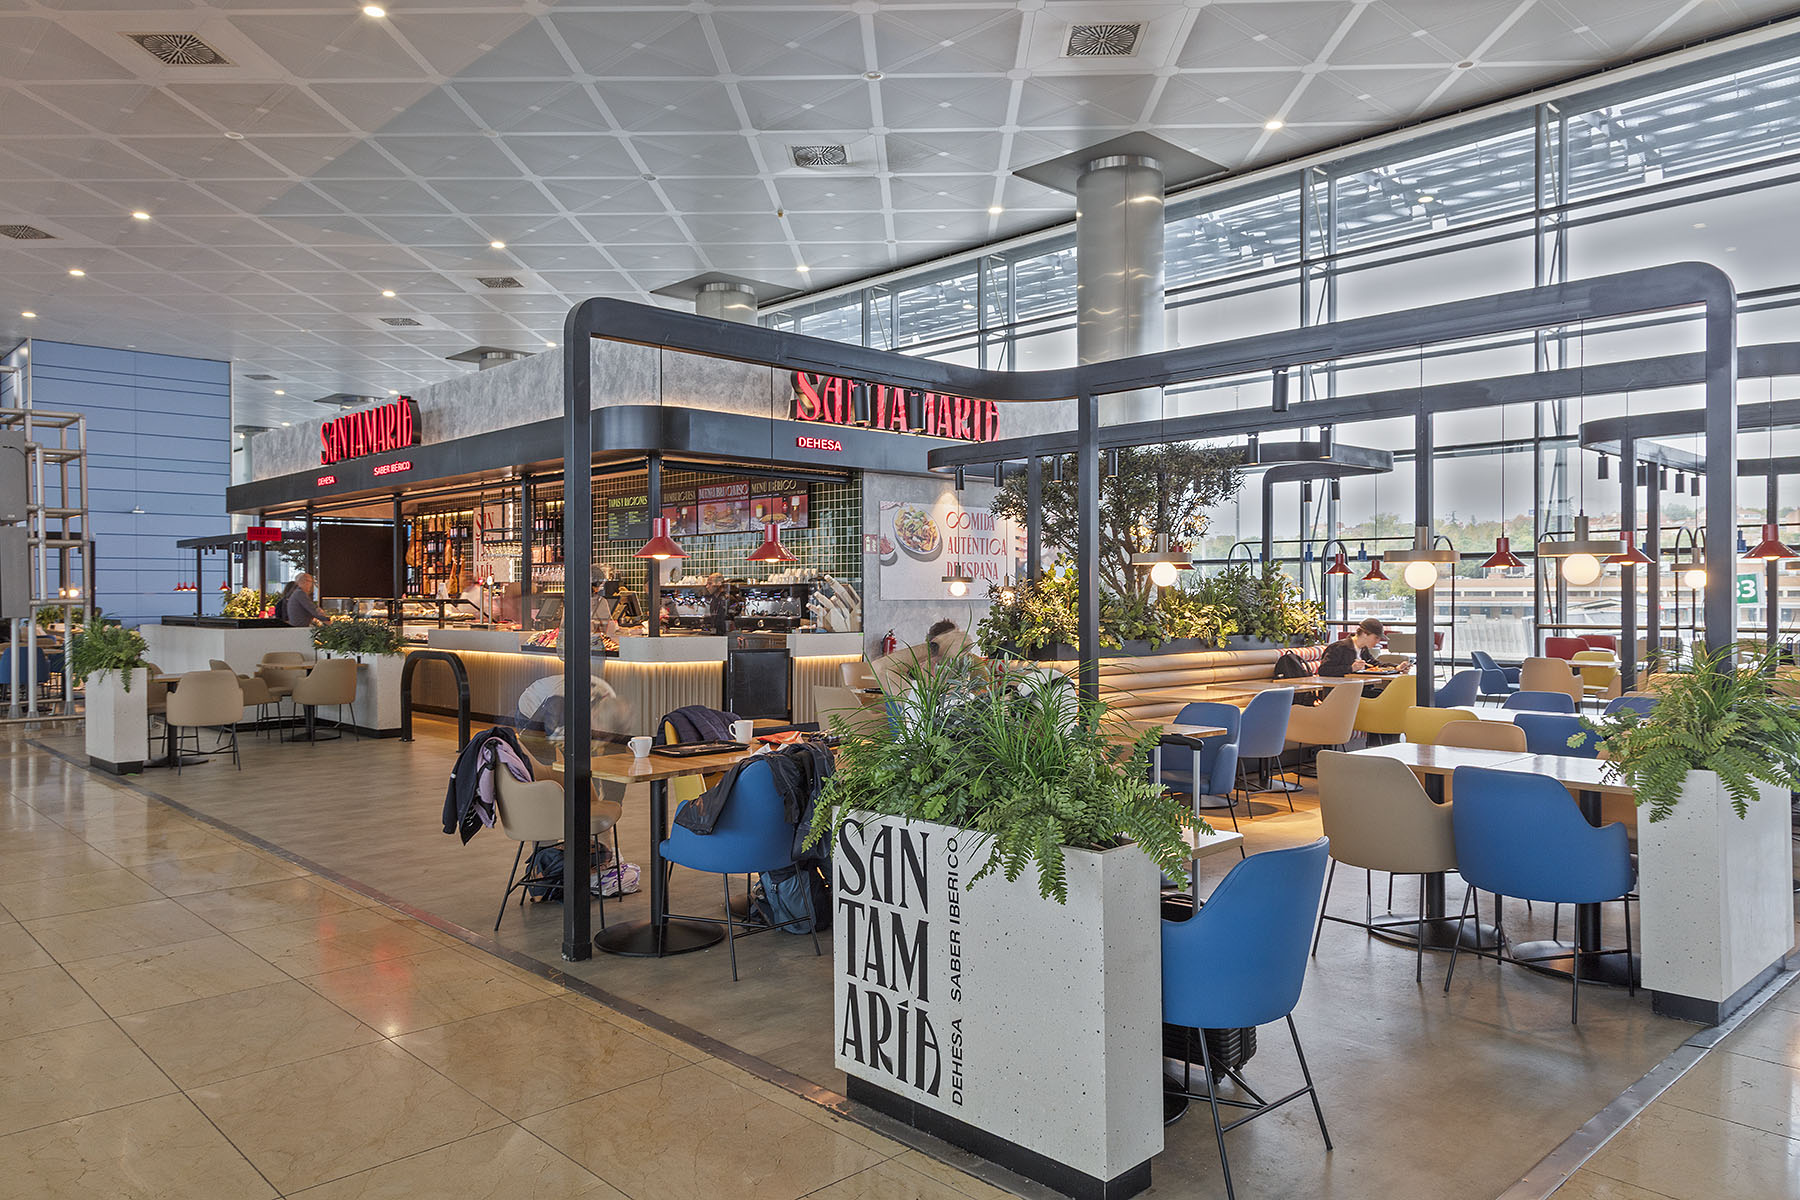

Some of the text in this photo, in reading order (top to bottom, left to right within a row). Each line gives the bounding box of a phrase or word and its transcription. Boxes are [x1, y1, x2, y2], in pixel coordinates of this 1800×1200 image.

[320, 395, 413, 465] SANTAMARÍA
[798, 436, 842, 451] DEHESA
[317, 475, 336, 487] DEHESA
[373, 465, 390, 476] SABER
[946, 511, 995, 532] COMIDA
[947, 535, 1007, 556] AUTÉNTICA
[962, 560, 998, 580] ESPAÑA
[839, 818, 930, 914] SAN
[838, 897, 930, 1003] TAM
[947, 837, 963, 1106] DEHESA SABER IBERICO
[840, 981, 942, 1098] ARÍA
